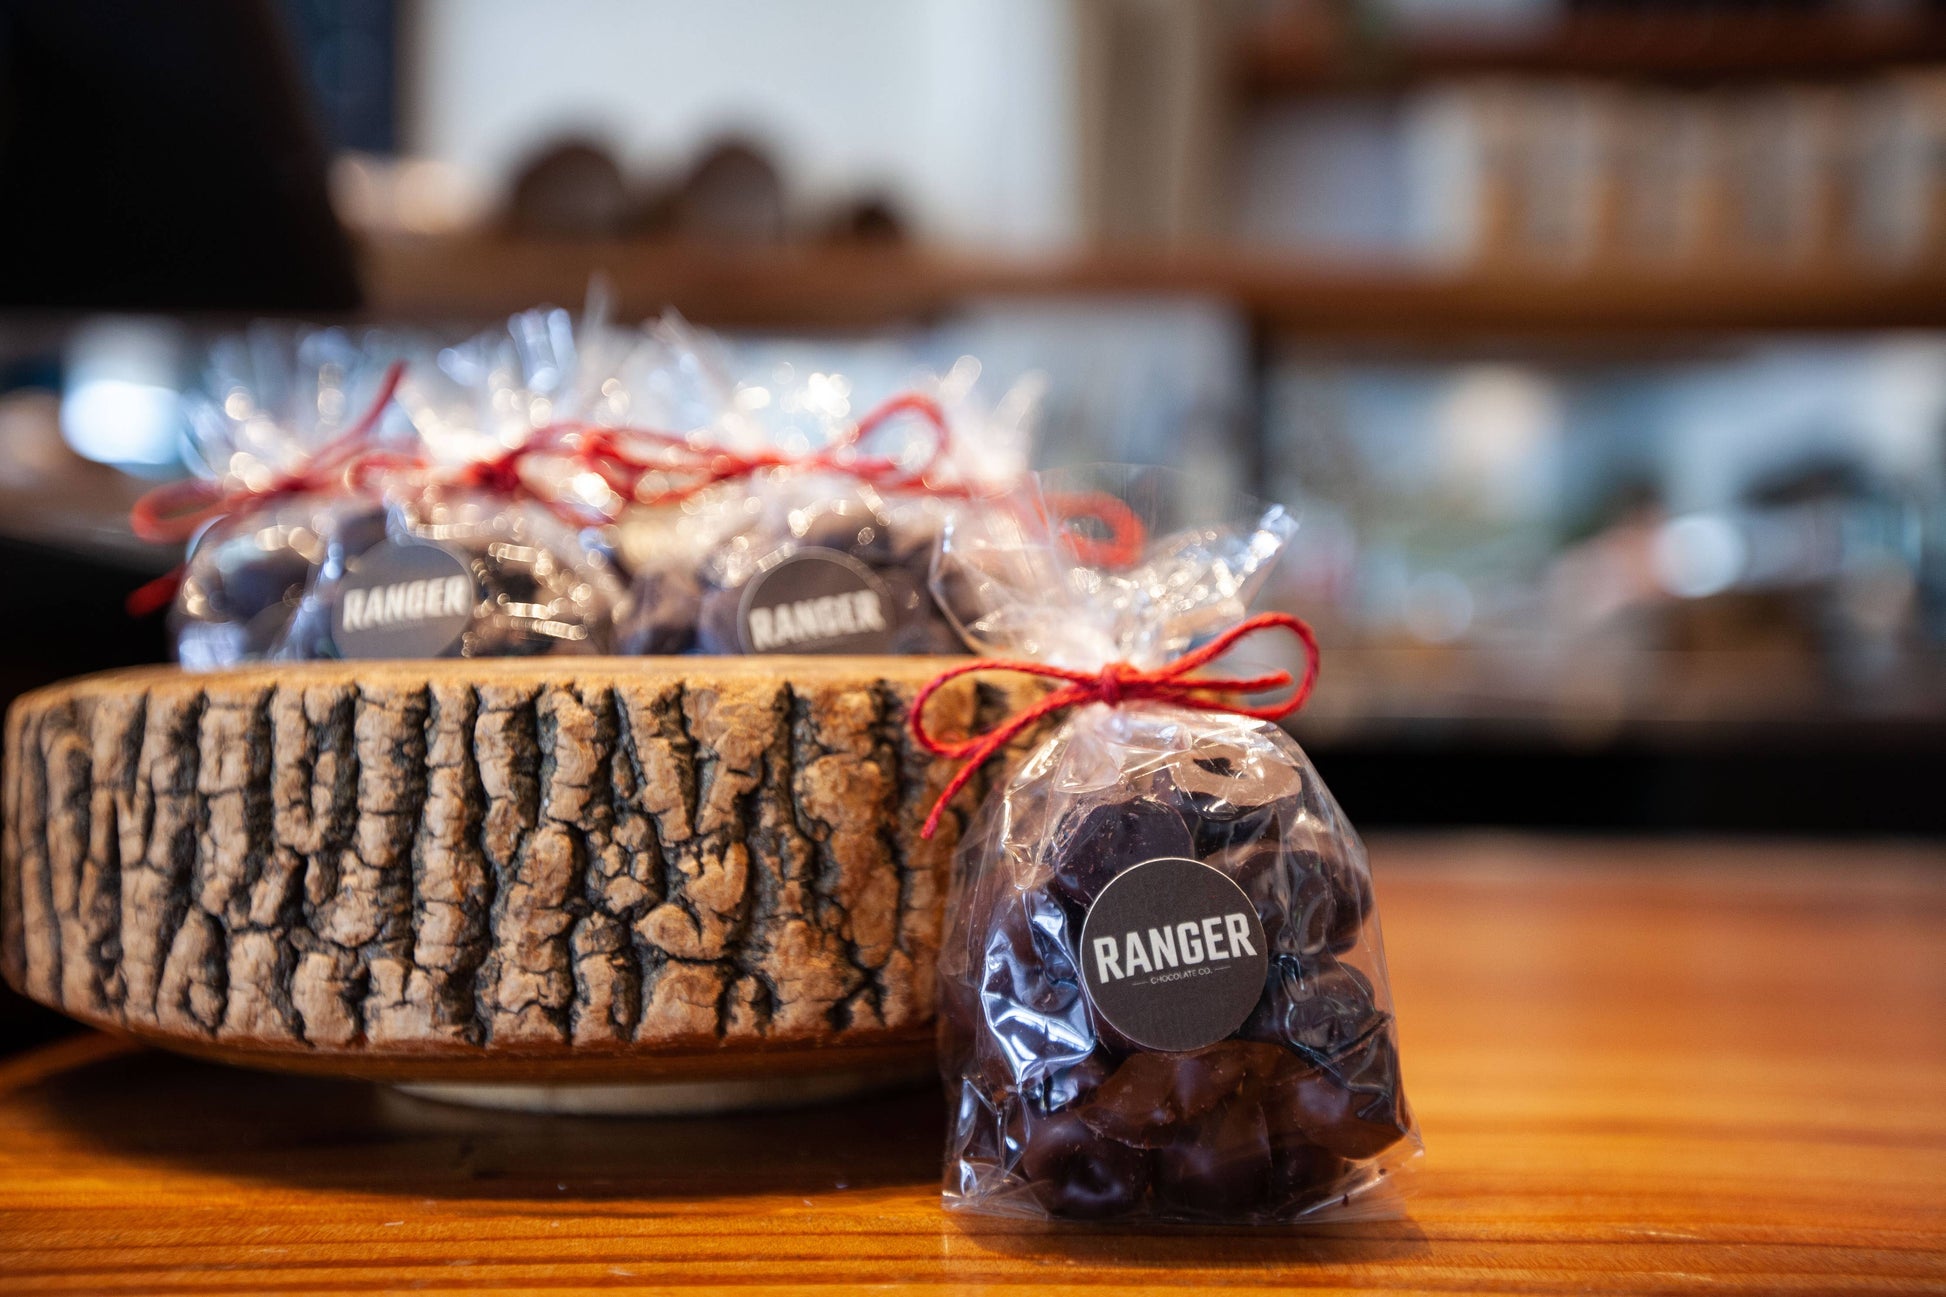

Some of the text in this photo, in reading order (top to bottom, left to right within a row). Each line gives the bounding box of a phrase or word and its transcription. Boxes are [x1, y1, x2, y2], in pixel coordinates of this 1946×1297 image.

[342, 573, 471, 633] RANGER
[750, 589, 886, 651] RANGER
[1093, 912, 1258, 984] RANGER
[1150, 967, 1213, 985] CHOCOLATE CO.
